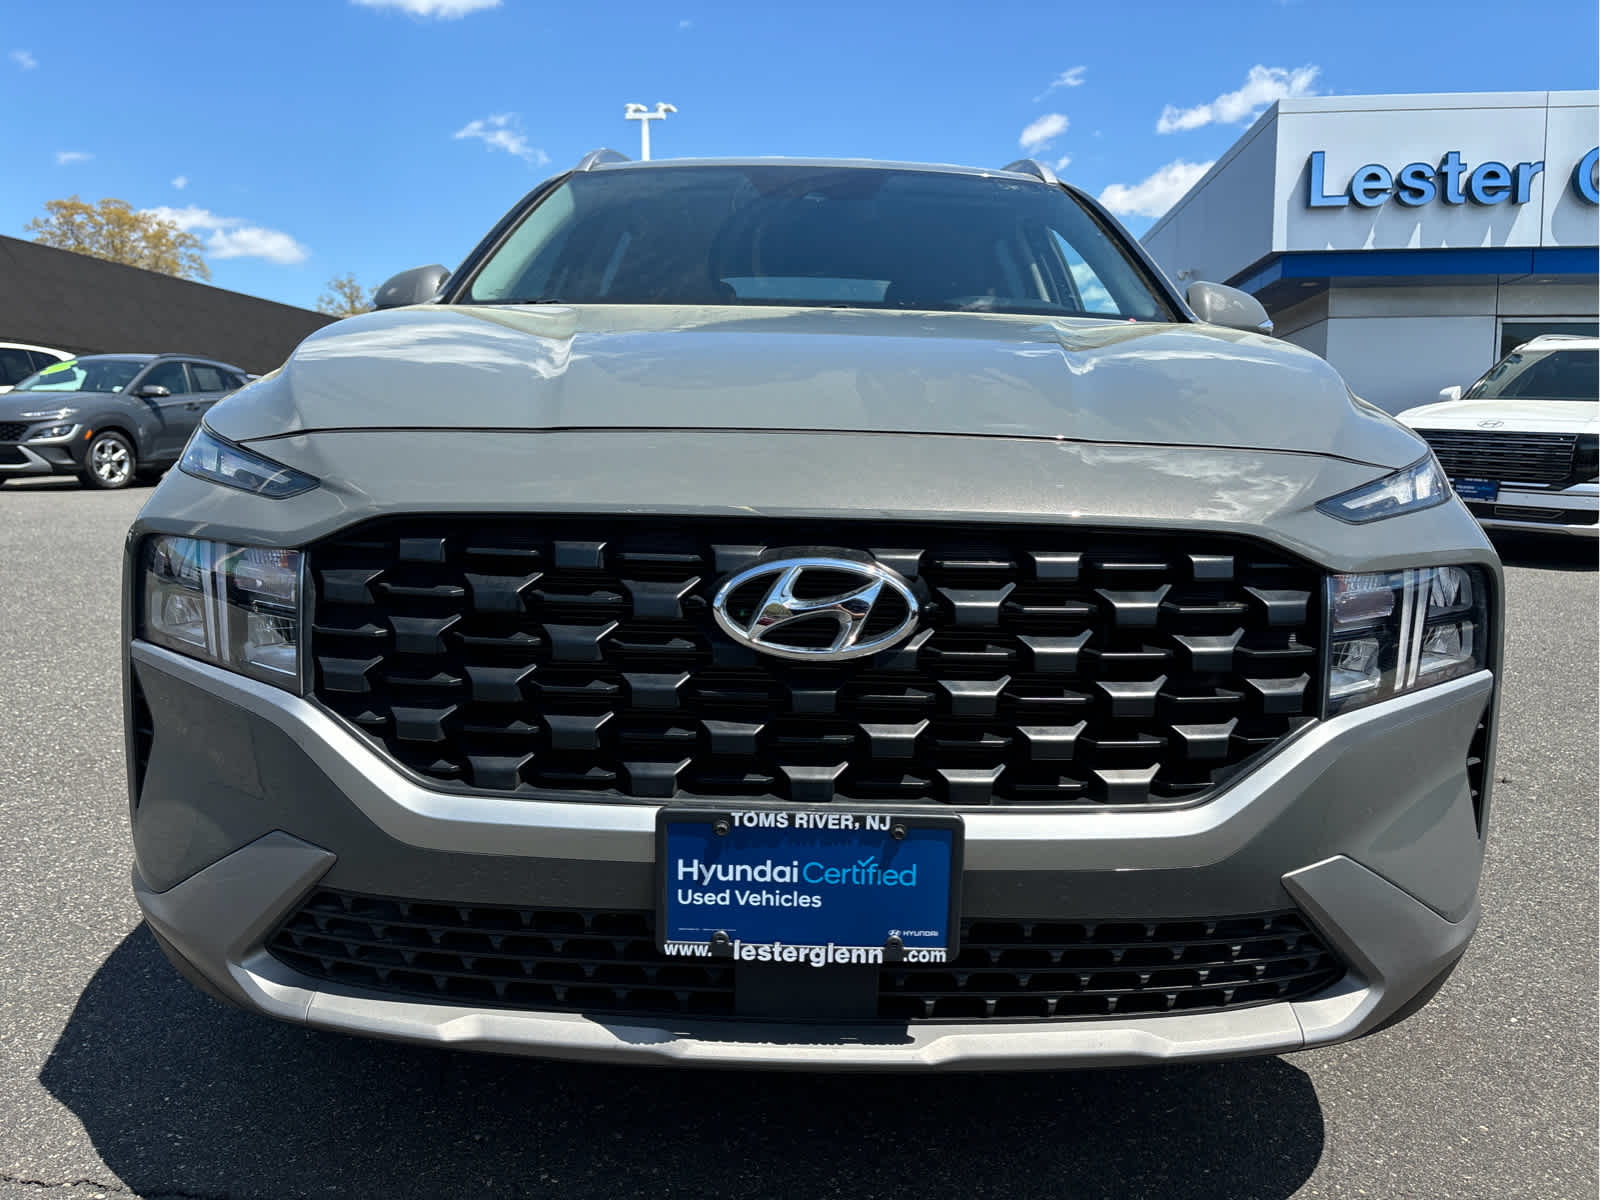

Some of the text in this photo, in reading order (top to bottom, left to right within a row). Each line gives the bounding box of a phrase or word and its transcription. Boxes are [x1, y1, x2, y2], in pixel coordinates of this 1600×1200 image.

[1307, 150, 1545, 208] Lester
[731, 811, 891, 832] TOMS RIVER, NJ
[677, 856, 917, 886] Hyundai Certified
[677, 889, 822, 908] Used Vehicles
[664, 939, 947, 968] www. lesterglenn .com
